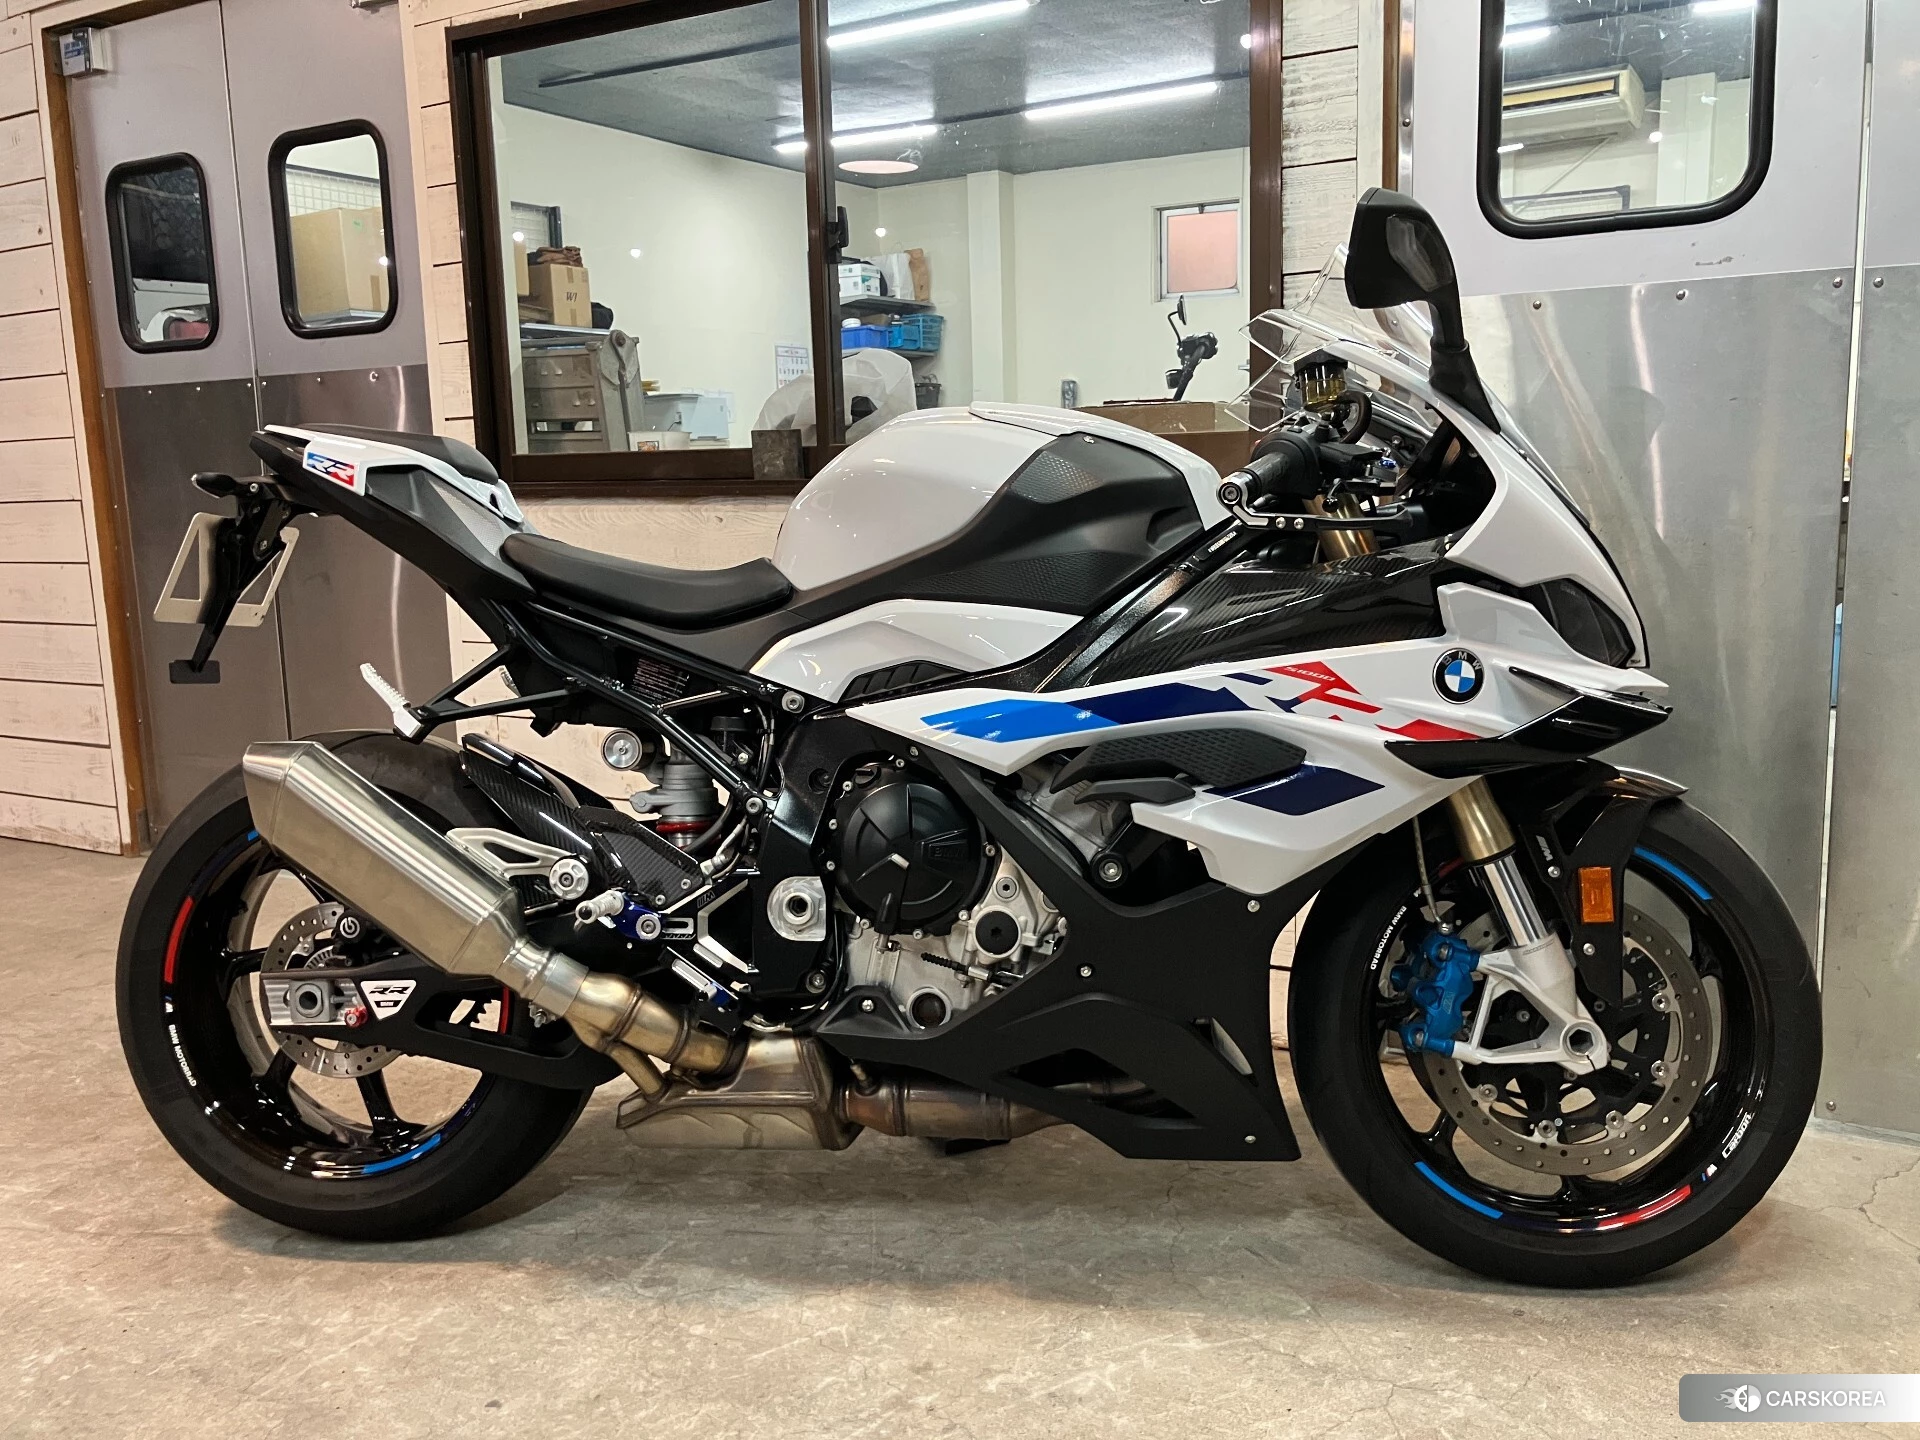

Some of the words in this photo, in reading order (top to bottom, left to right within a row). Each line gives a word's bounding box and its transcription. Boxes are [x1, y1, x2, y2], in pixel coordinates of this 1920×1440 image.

[1441, 651, 1482, 670] BMW
[1283, 666, 1336, 682] S1000
[1391, 905, 1407, 926] BMW
[1370, 925, 1394, 970] MOTORRAD
[369, 984, 410, 995] RR
[168, 1024, 180, 1045] BMW
[174, 1044, 197, 1087] MOTORRAD
